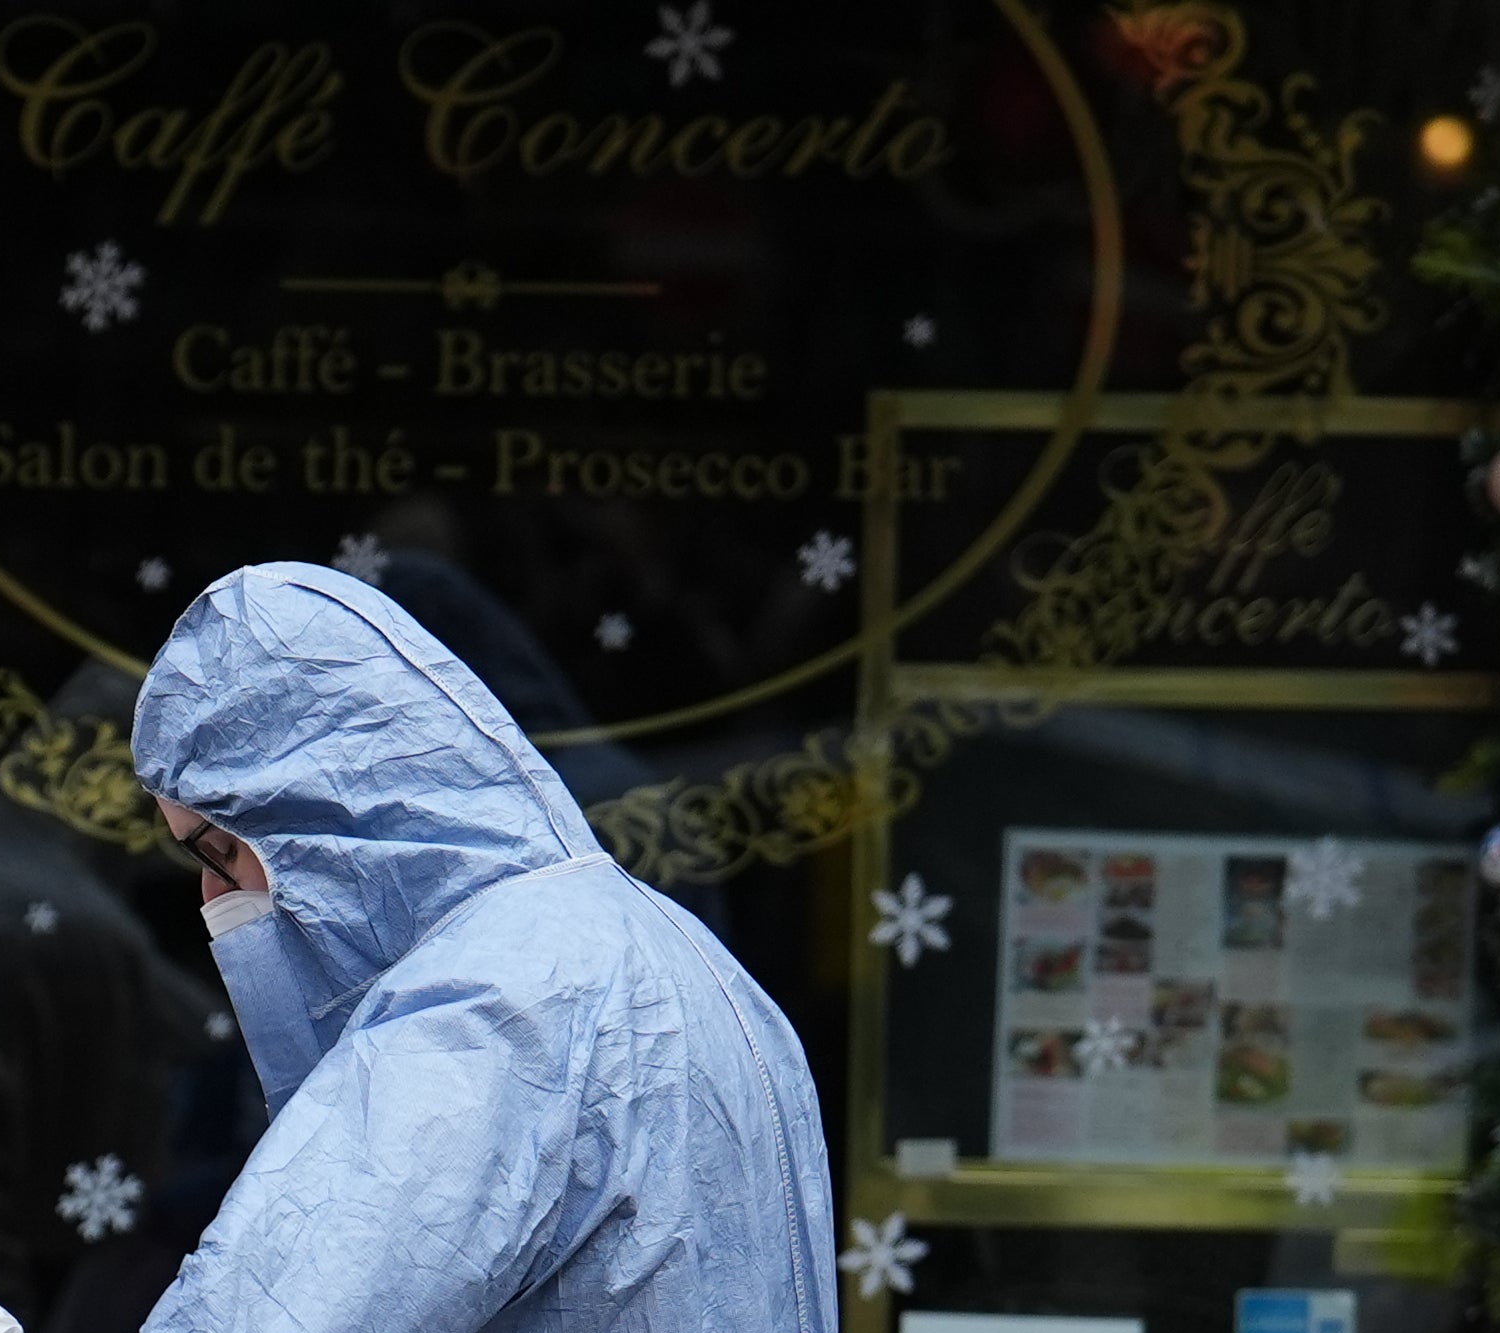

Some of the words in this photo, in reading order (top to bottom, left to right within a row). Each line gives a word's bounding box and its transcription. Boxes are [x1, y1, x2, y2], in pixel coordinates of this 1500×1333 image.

[397, 17, 958, 188] Concerto
[170, 321, 360, 395] Caffé
[432, 326, 770, 399] Brasserie
[191, 420, 279, 495] de
[300, 422, 417, 496] thé
[489, 425, 811, 500] Prosecco
